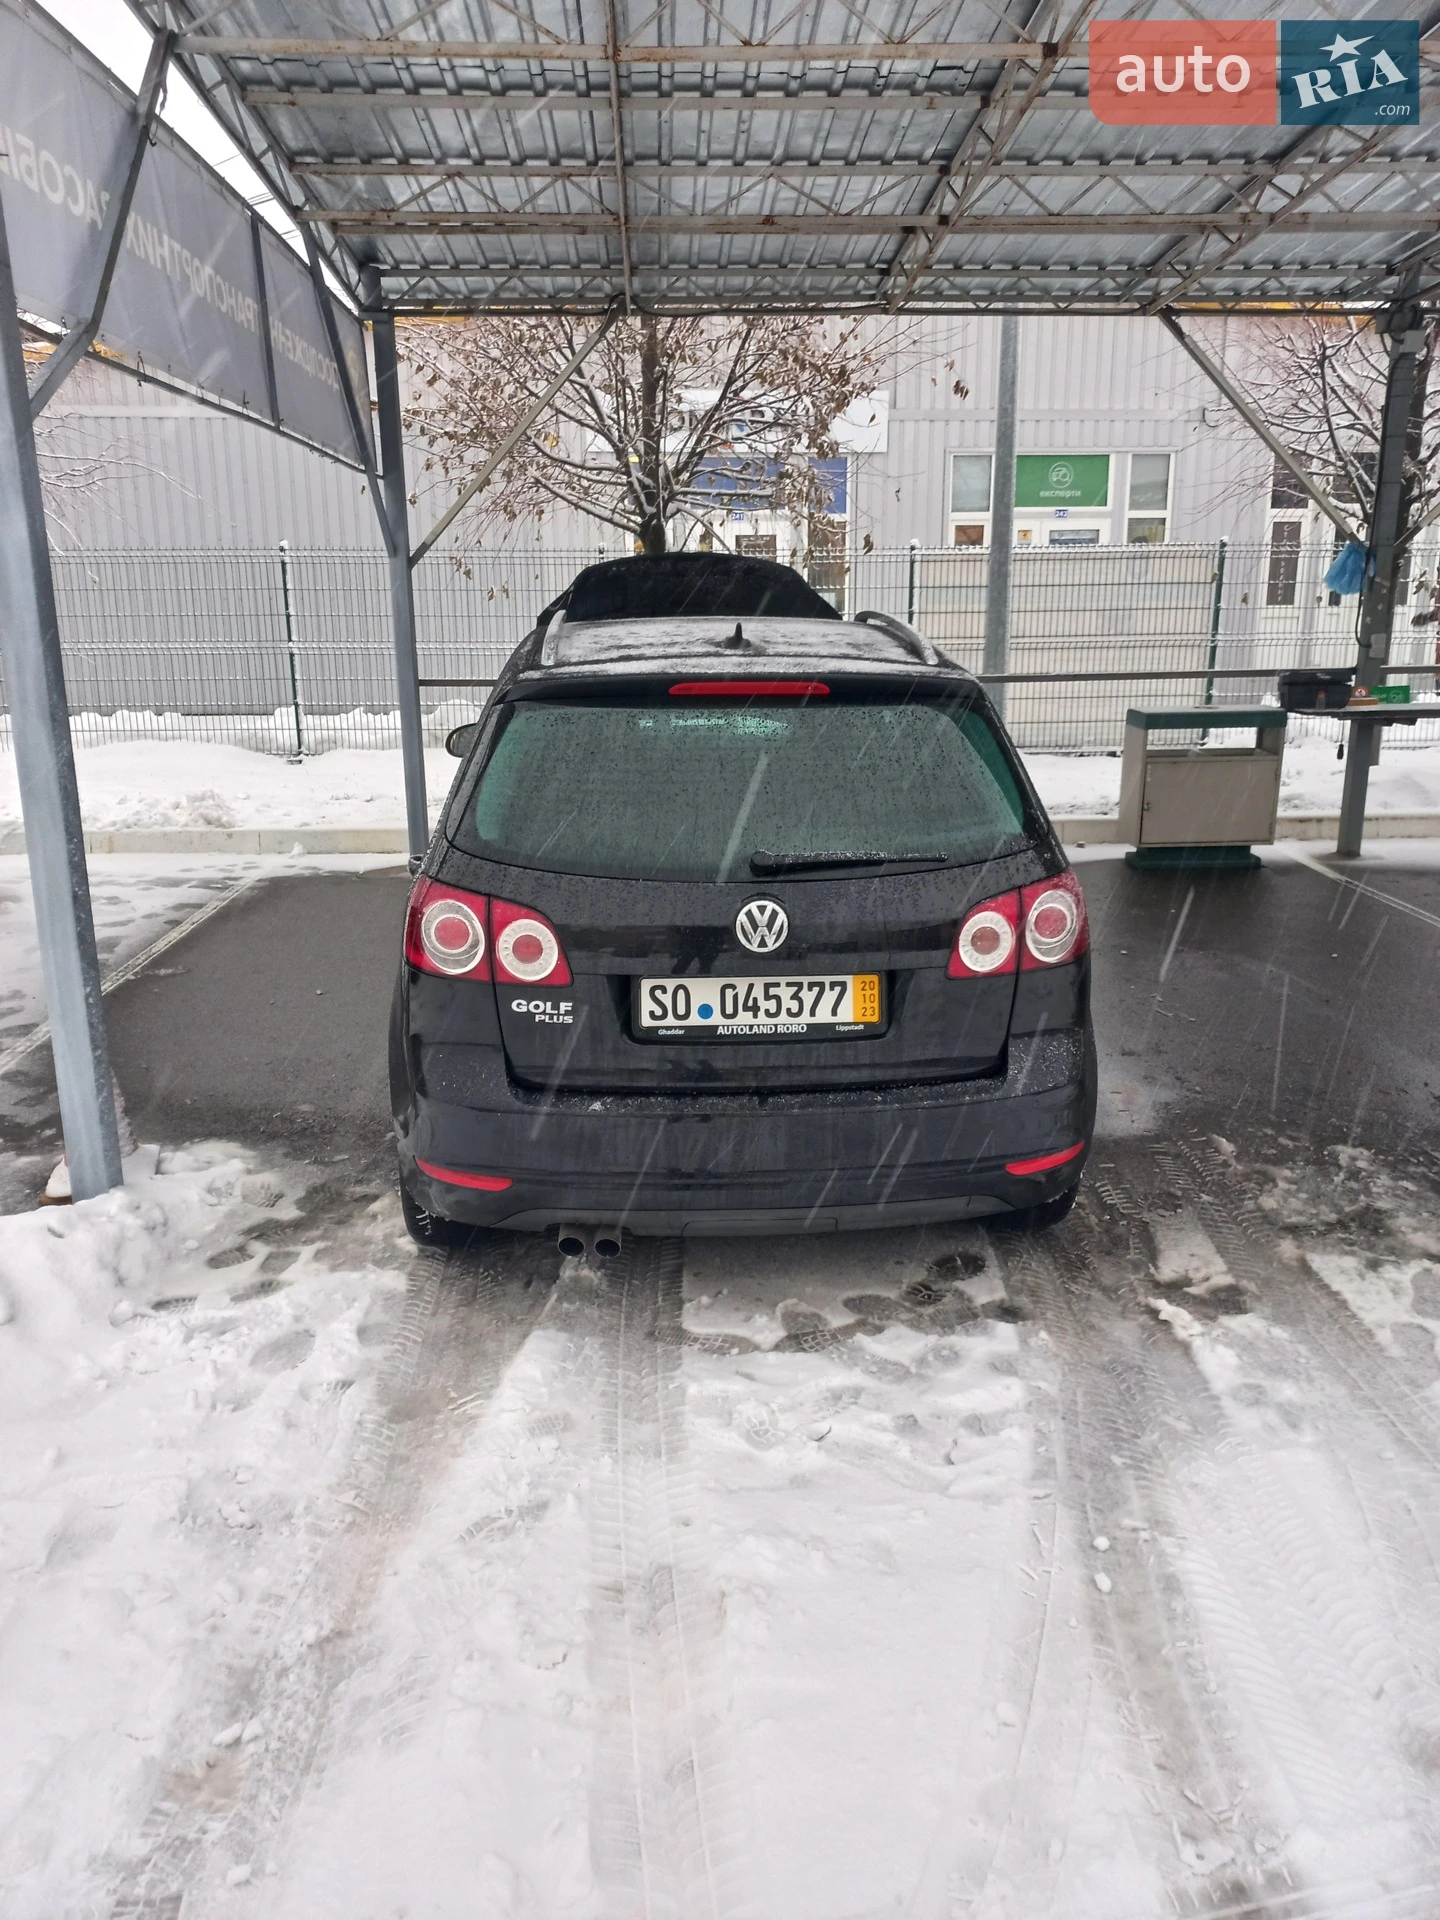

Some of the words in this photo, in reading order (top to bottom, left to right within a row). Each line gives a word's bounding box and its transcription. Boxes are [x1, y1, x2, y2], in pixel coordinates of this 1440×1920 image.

[1039, 490, 1082, 499] експерти
[860, 980, 876, 991] 20
[648, 984, 691, 1021] SO
[719, 980, 848, 1020] 045377
[862, 993, 876, 1004] 10
[511, 999, 573, 1014] GOLF
[861, 1006, 876, 1017] 23
[535, 1014, 573, 1023] PLUS
[717, 1024, 775, 1035] AUTOLAND
[777, 1024, 807, 1034] RORO
[836, 1024, 864, 1032] Lippstadt
